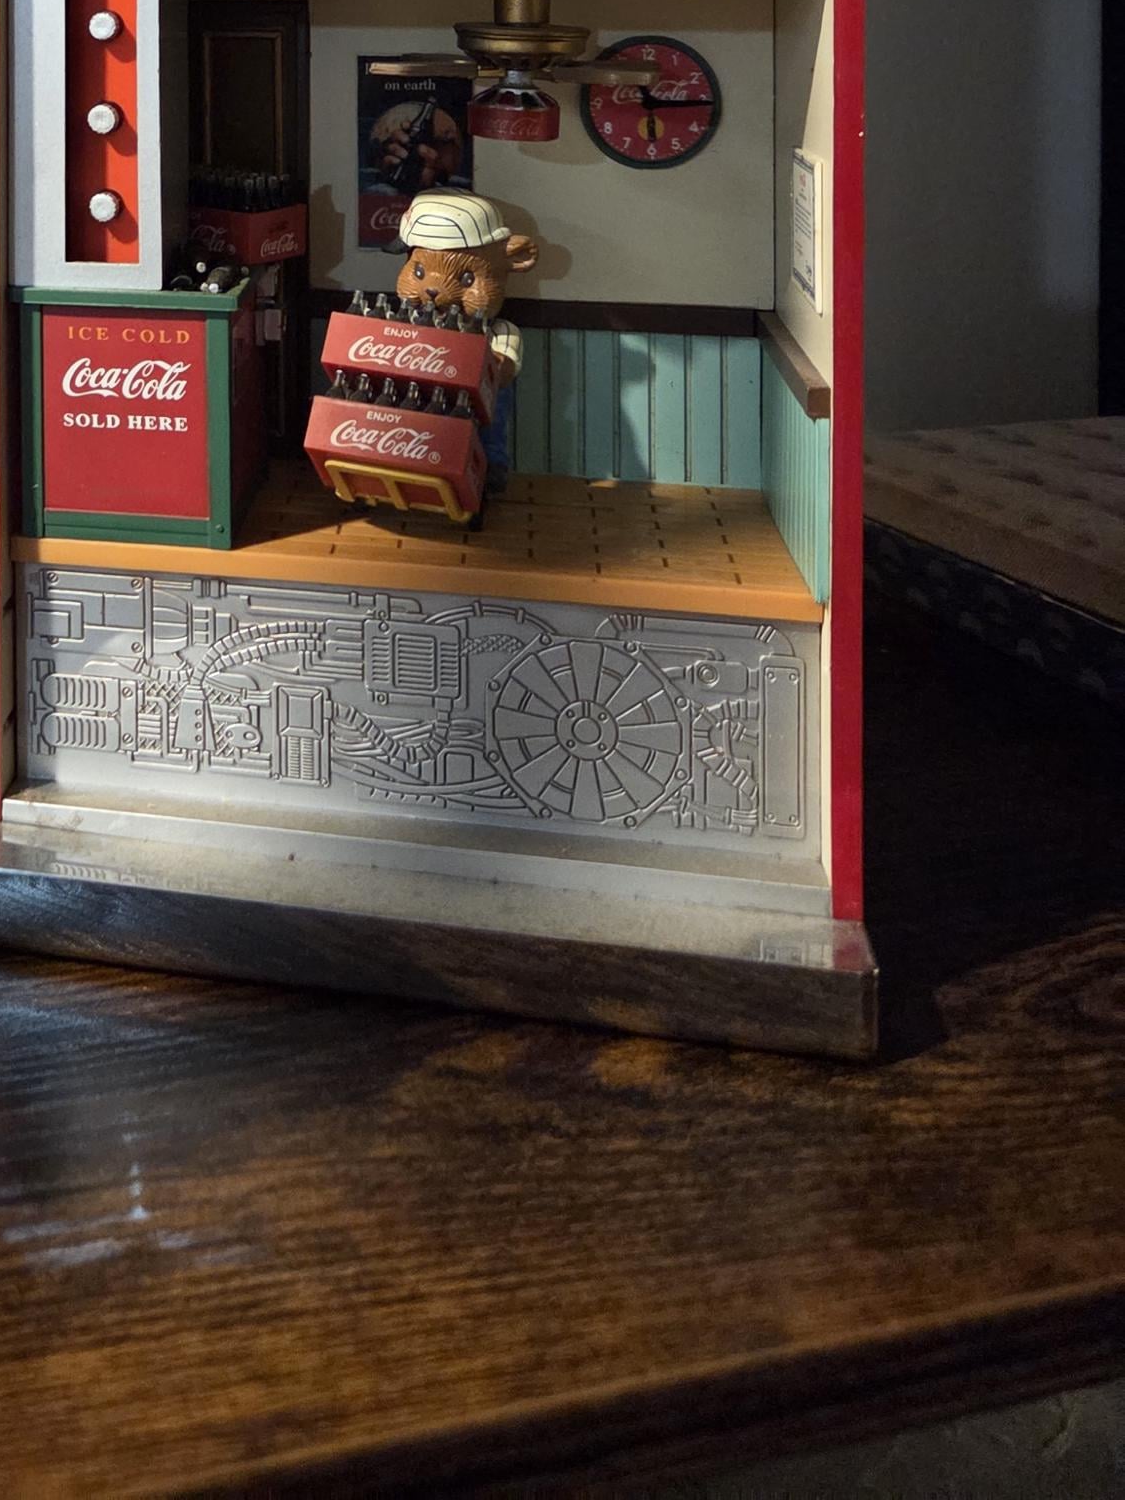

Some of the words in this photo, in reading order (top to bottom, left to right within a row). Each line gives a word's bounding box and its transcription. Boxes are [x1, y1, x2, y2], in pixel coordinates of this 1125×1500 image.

[641, 47, 656, 61] 12
[384, 81, 401, 92] on
[403, 78, 437, 92] earth
[689, 71, 702, 85] 2
[603, 121, 613, 135] 8
[688, 120, 700, 133] 4
[622, 136, 632, 149] 7
[646, 141, 657, 156] 6
[671, 137, 681, 151] 5
[67, 325, 110, 342] ICE
[122, 327, 191, 345] COLD
[383, 326, 419, 340] ENJOY
[347, 335, 451, 374] Coca-Cola
[61, 357, 192, 401] Coca-Cola
[63, 412, 121, 429] SOLD
[127, 414, 188, 432] HERE
[366, 410, 402, 424] ENJOY
[330, 419, 435, 460] Coca-Cola
